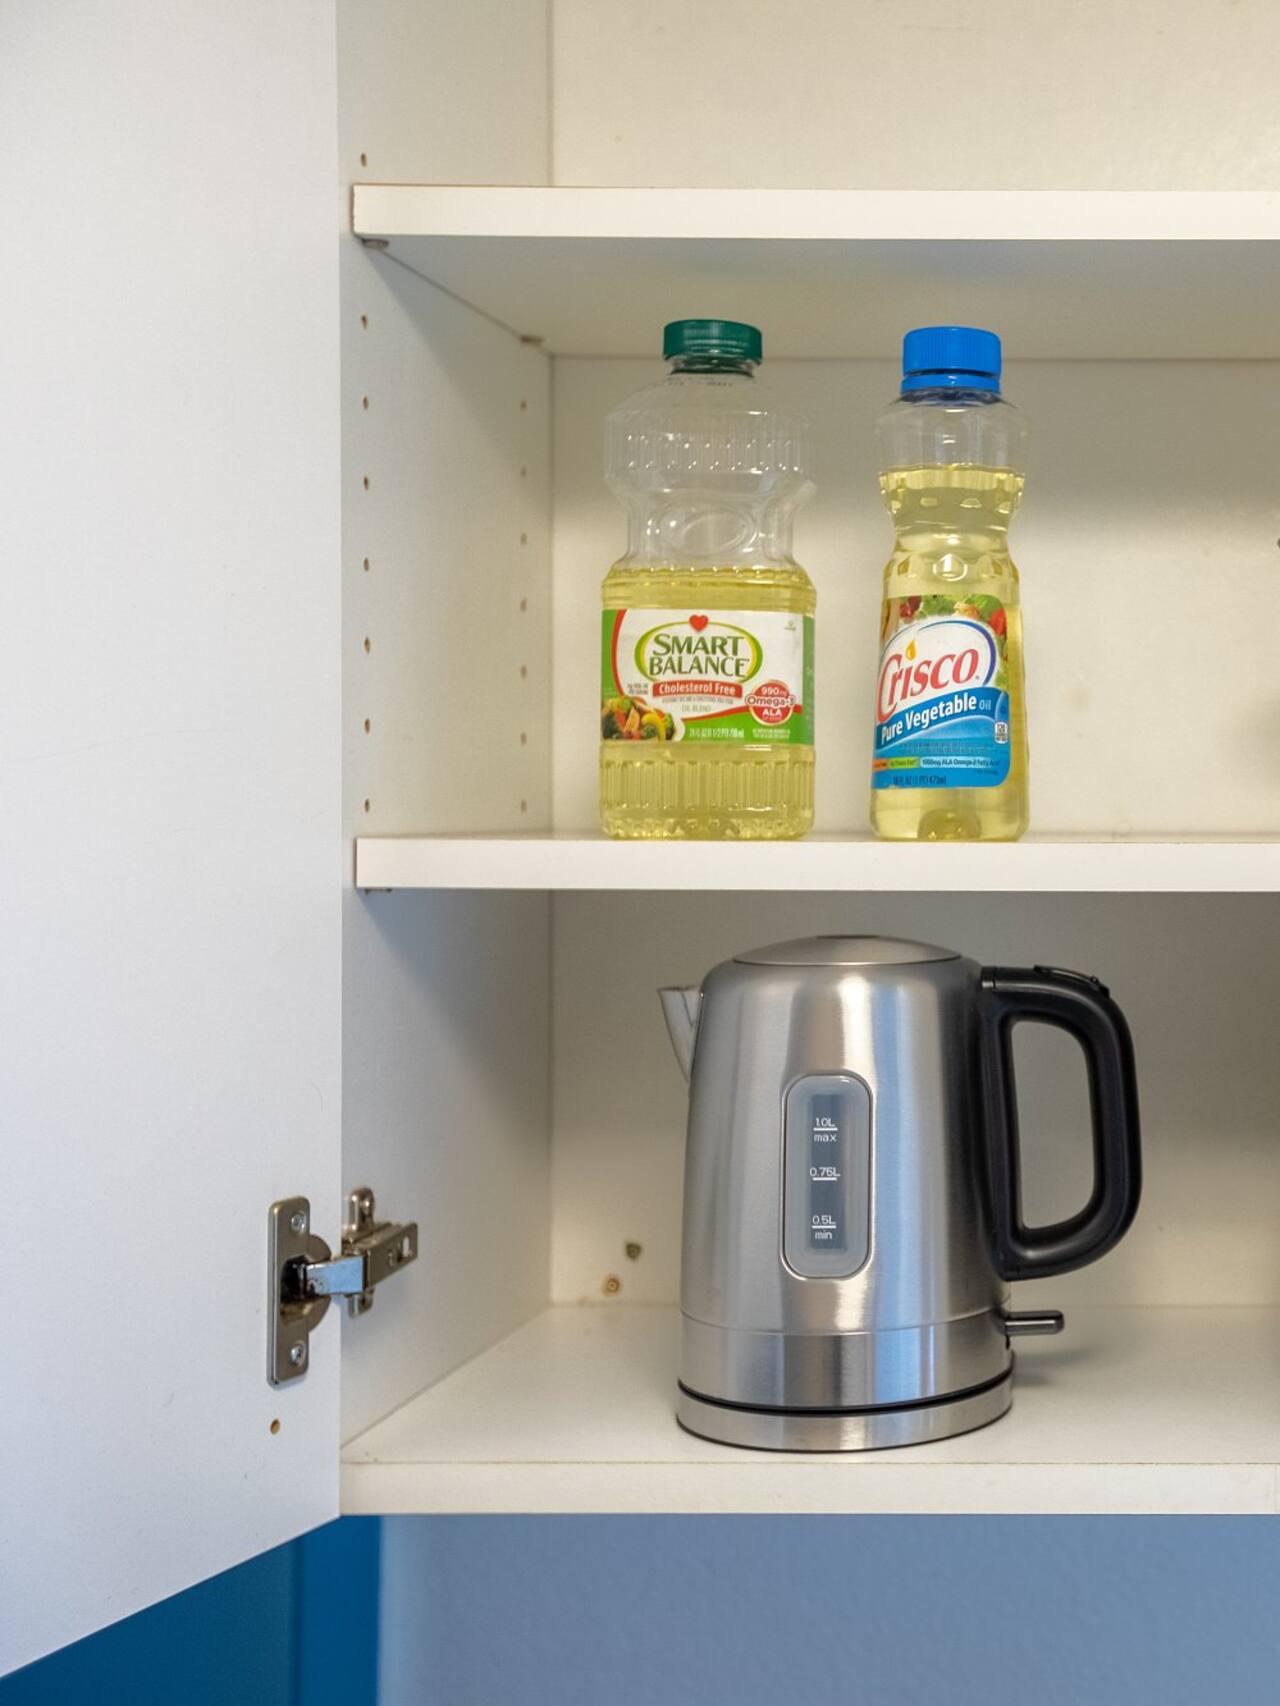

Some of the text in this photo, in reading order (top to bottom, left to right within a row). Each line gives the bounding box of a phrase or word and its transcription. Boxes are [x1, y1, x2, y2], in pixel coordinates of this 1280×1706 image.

[652, 634, 744, 656] SMART
[649, 656, 748, 678] BALANCE
[659, 682, 712, 696] Cholesterol
[715, 683, 736, 696] Free
[761, 686, 780, 696] 990
[748, 694, 796, 706] Omega-3
[762, 708, 782, 716] ALA
[880, 693, 992, 745] Pure Vegetable Oil
[814, 1134, 837, 1142] max
[810, 1167, 840, 1177] 0.75L
[812, 1216, 836, 1225] 0.5L
[814, 1230, 832, 1240] min
